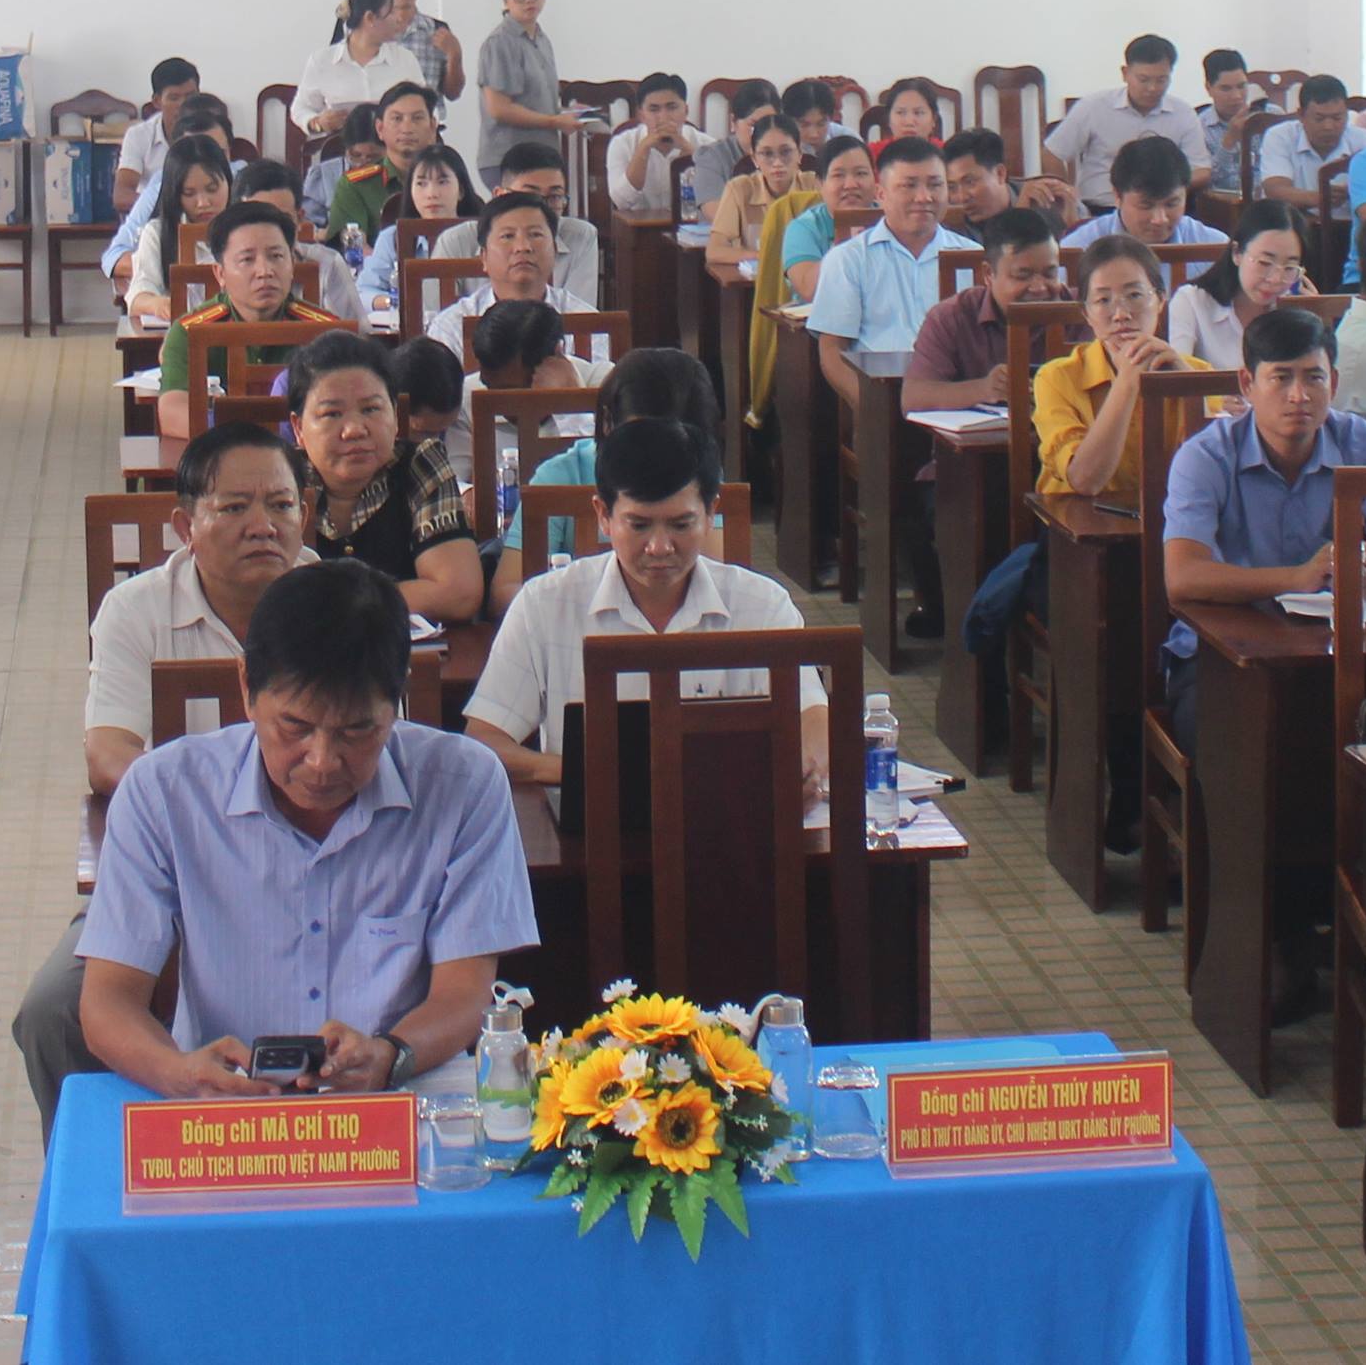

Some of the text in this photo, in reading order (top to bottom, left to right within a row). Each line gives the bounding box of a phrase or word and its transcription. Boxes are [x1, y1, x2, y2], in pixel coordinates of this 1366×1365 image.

[921, 1086, 958, 1117] Đồng
[962, 1086, 985, 1113] chí
[989, 1075, 1048, 1112] NGUYỄN
[182, 1110, 359, 1147] Đồng chí MÃ CHÍ THỌ
[933, 1125, 951, 1147] THƯ
[952, 1125, 962, 1146] TT
[1006, 1116, 1025, 1143] CHỦ
[179, 1149, 204, 1178] CHỦ
[206, 1155, 234, 1182] TỊCH
[238, 1154, 286, 1178] UBMTTQ
[290, 1148, 315, 1179] VIỆT
[318, 1152, 347, 1173] NAM
[350, 1145, 400, 1172] PHƯỜNG
